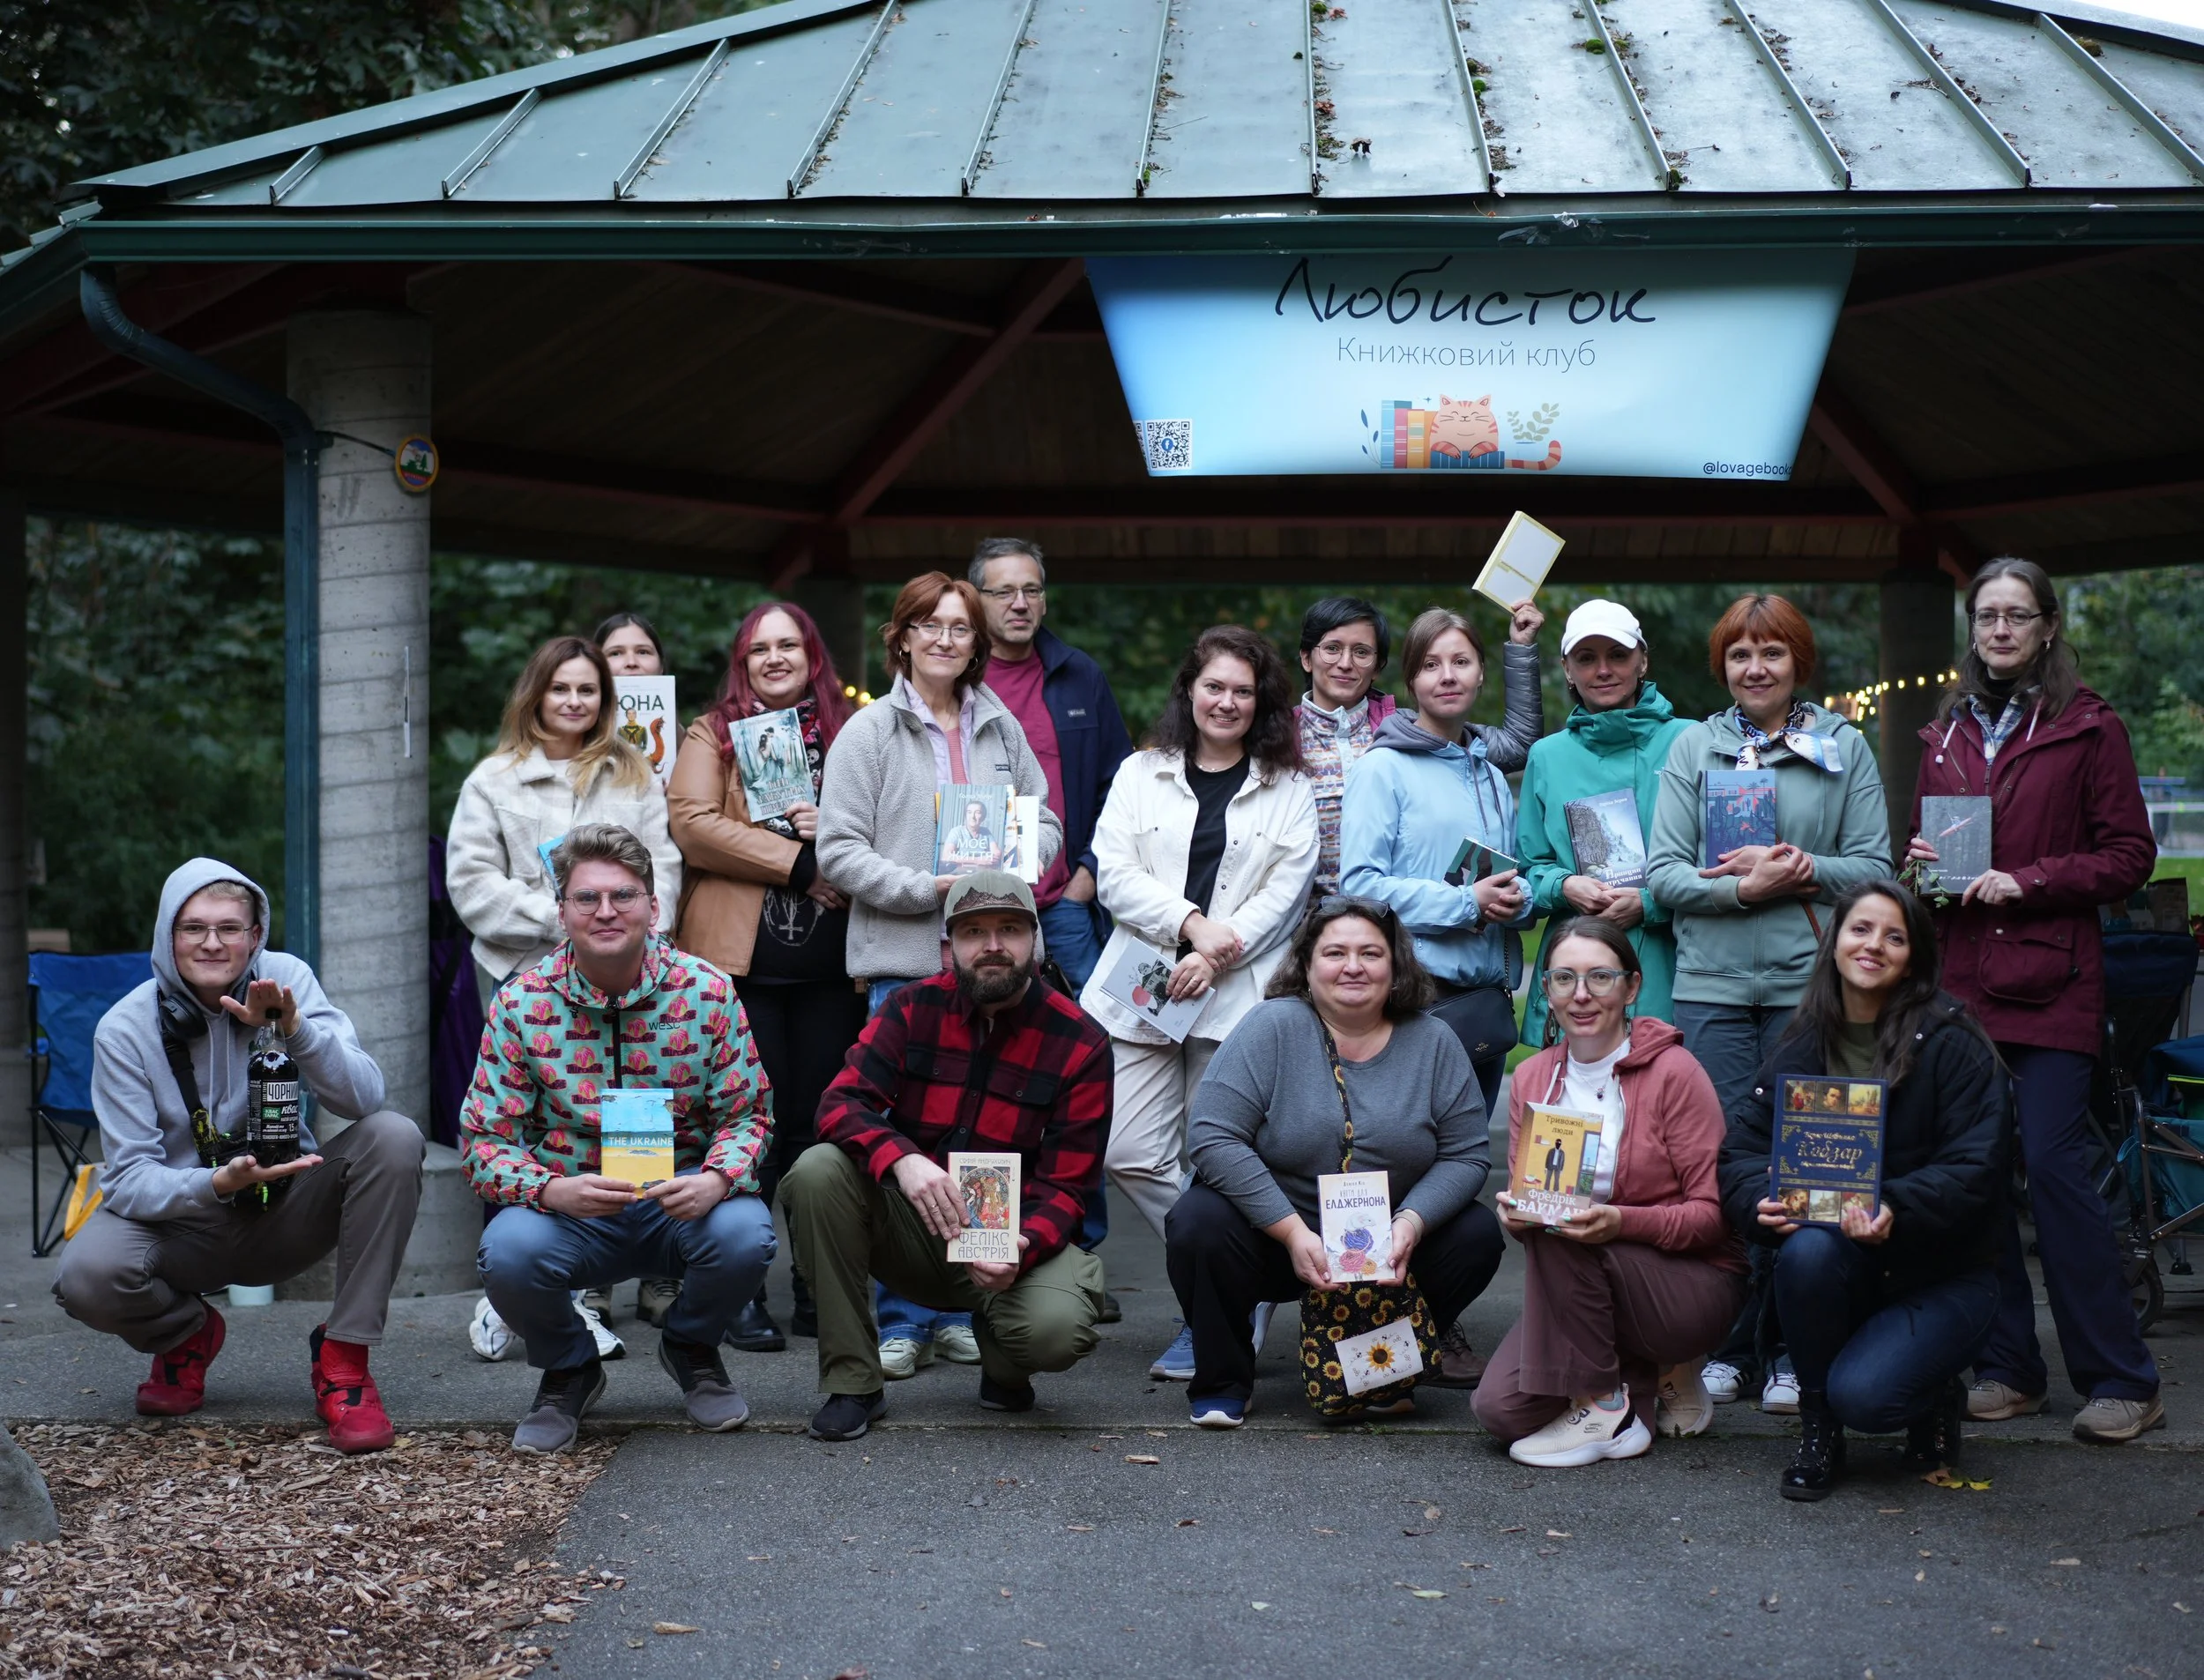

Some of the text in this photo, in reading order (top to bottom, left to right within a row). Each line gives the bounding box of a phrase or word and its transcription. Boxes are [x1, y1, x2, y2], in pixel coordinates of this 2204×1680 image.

[1275, 255, 1656, 326] Любисток
[1338, 337, 1596, 373] Книжковий клуб
[957, 838, 988, 849] МОЄ
[947, 851, 994, 861] ЖИТТЯ
[1606, 874, 1642, 887] тручання
[1545, 1115, 1583, 1127] Тривожні
[609, 1137, 674, 1146] THE UKRAINE
[1325, 1196, 1386, 1209] ЕЛДЖЕРНОНА
[1528, 1188, 1576, 1207] Фредрік
[958, 1231, 1009, 1245] ФЕЛІКС
[957, 1246, 1009, 1259] АВСТРІЯ
